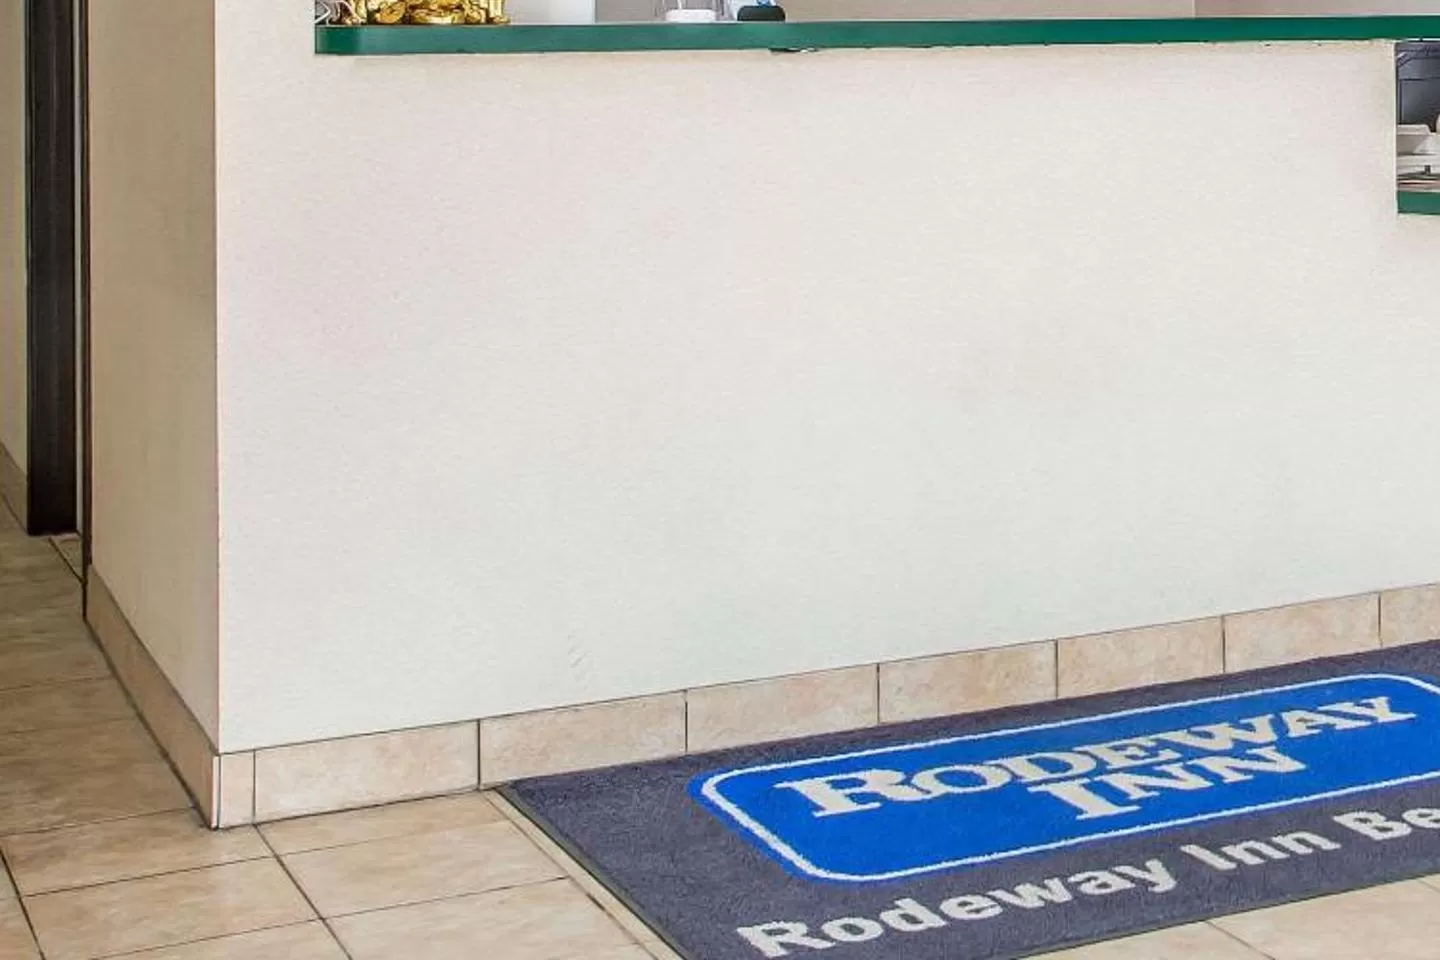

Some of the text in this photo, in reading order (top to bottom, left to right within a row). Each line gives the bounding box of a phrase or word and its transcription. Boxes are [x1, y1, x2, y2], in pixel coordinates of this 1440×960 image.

[774, 696, 1416, 818] RODEWAY
[1028, 745, 1306, 821] INN
[736, 856, 1178, 959] Rodeway
[1181, 829, 1343, 872] Inn
